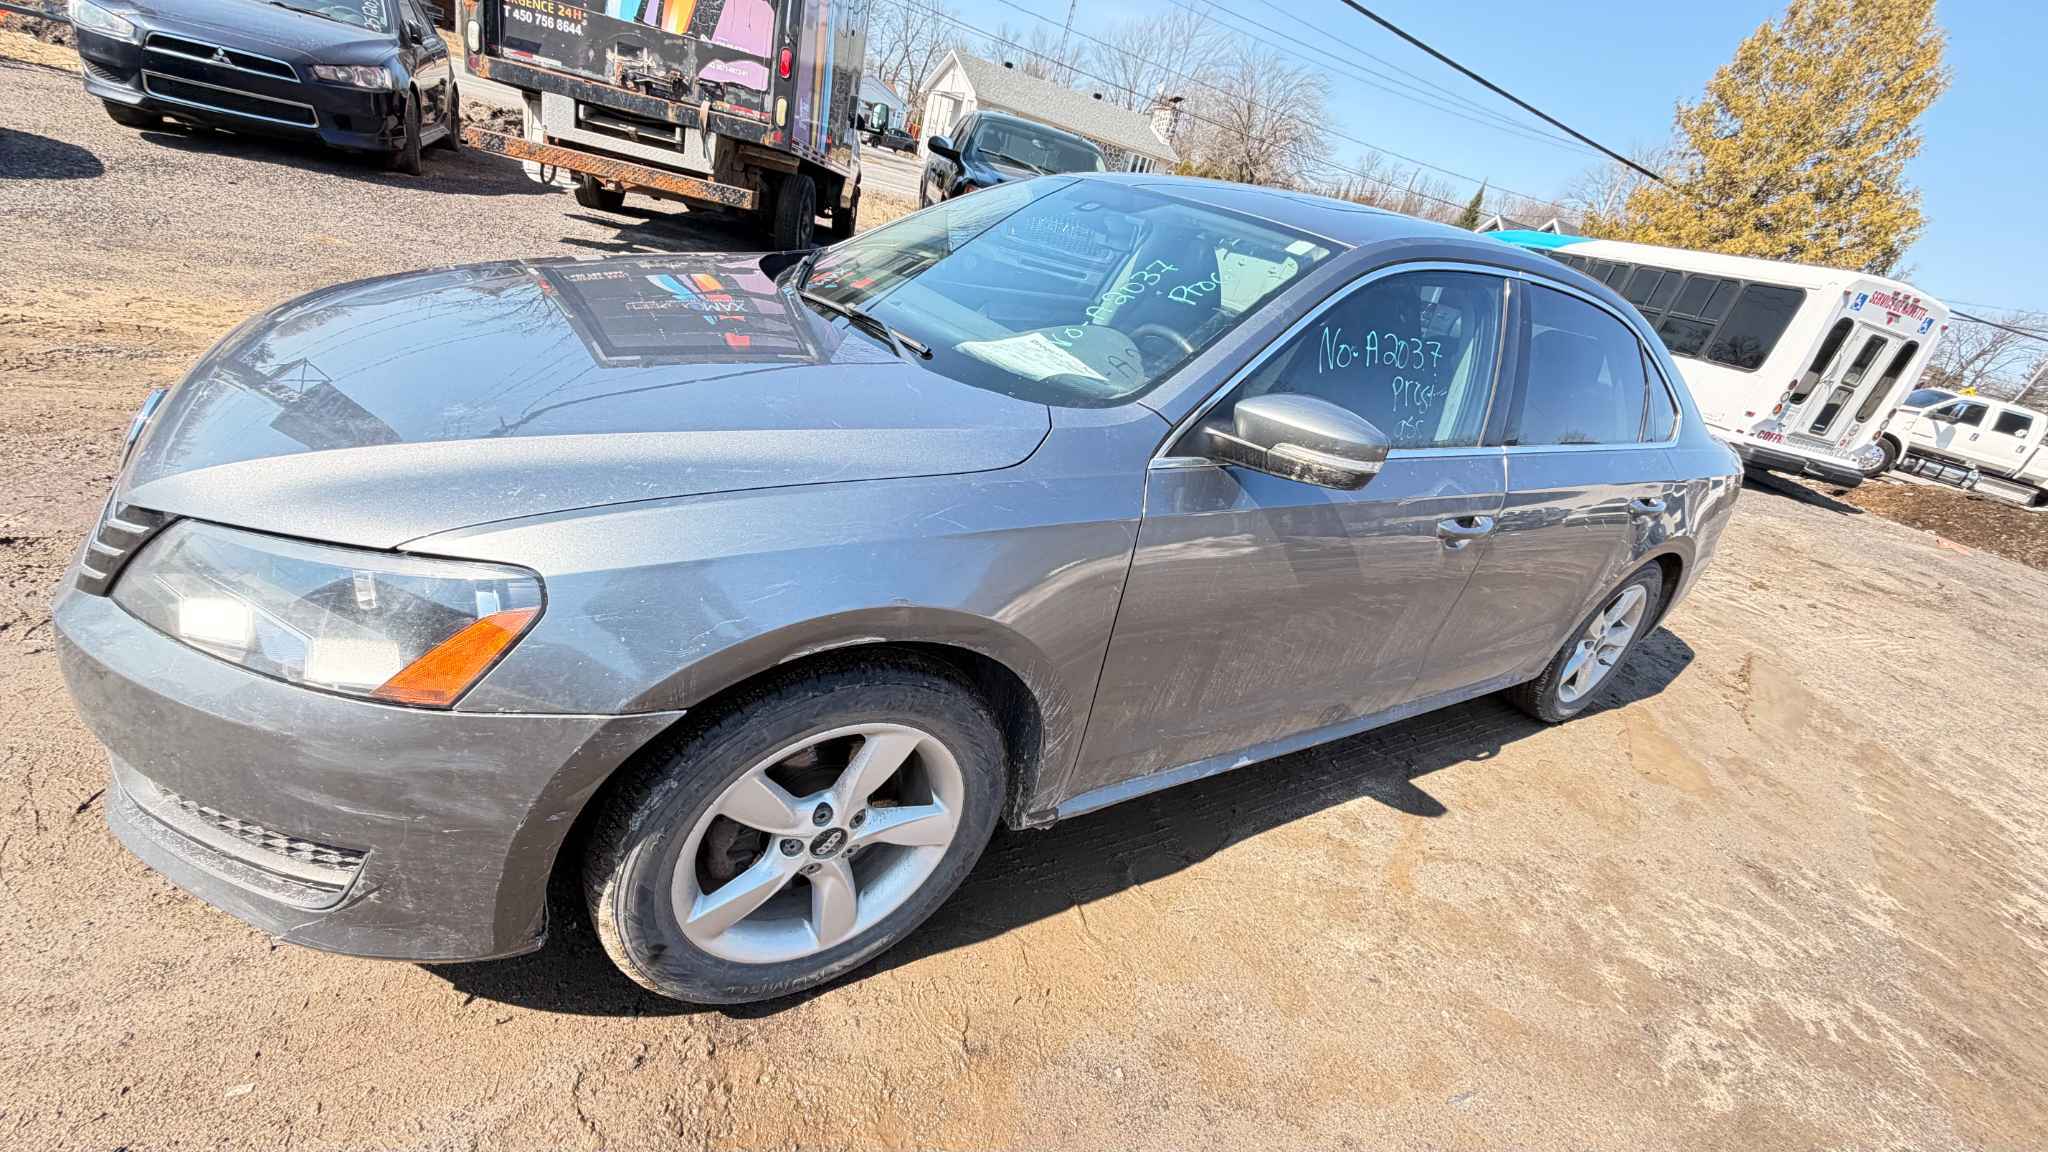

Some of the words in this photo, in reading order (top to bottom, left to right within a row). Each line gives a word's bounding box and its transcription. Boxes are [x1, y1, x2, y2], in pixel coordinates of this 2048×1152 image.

[504, 0, 554, 14] RGENCE
[558, 4, 582, 20] 24H
[504, 5, 511, 18] T
[513, 9, 533, 23] 450
[535, 13, 554, 29] 756
[556, 19, 583, 36] 8644
